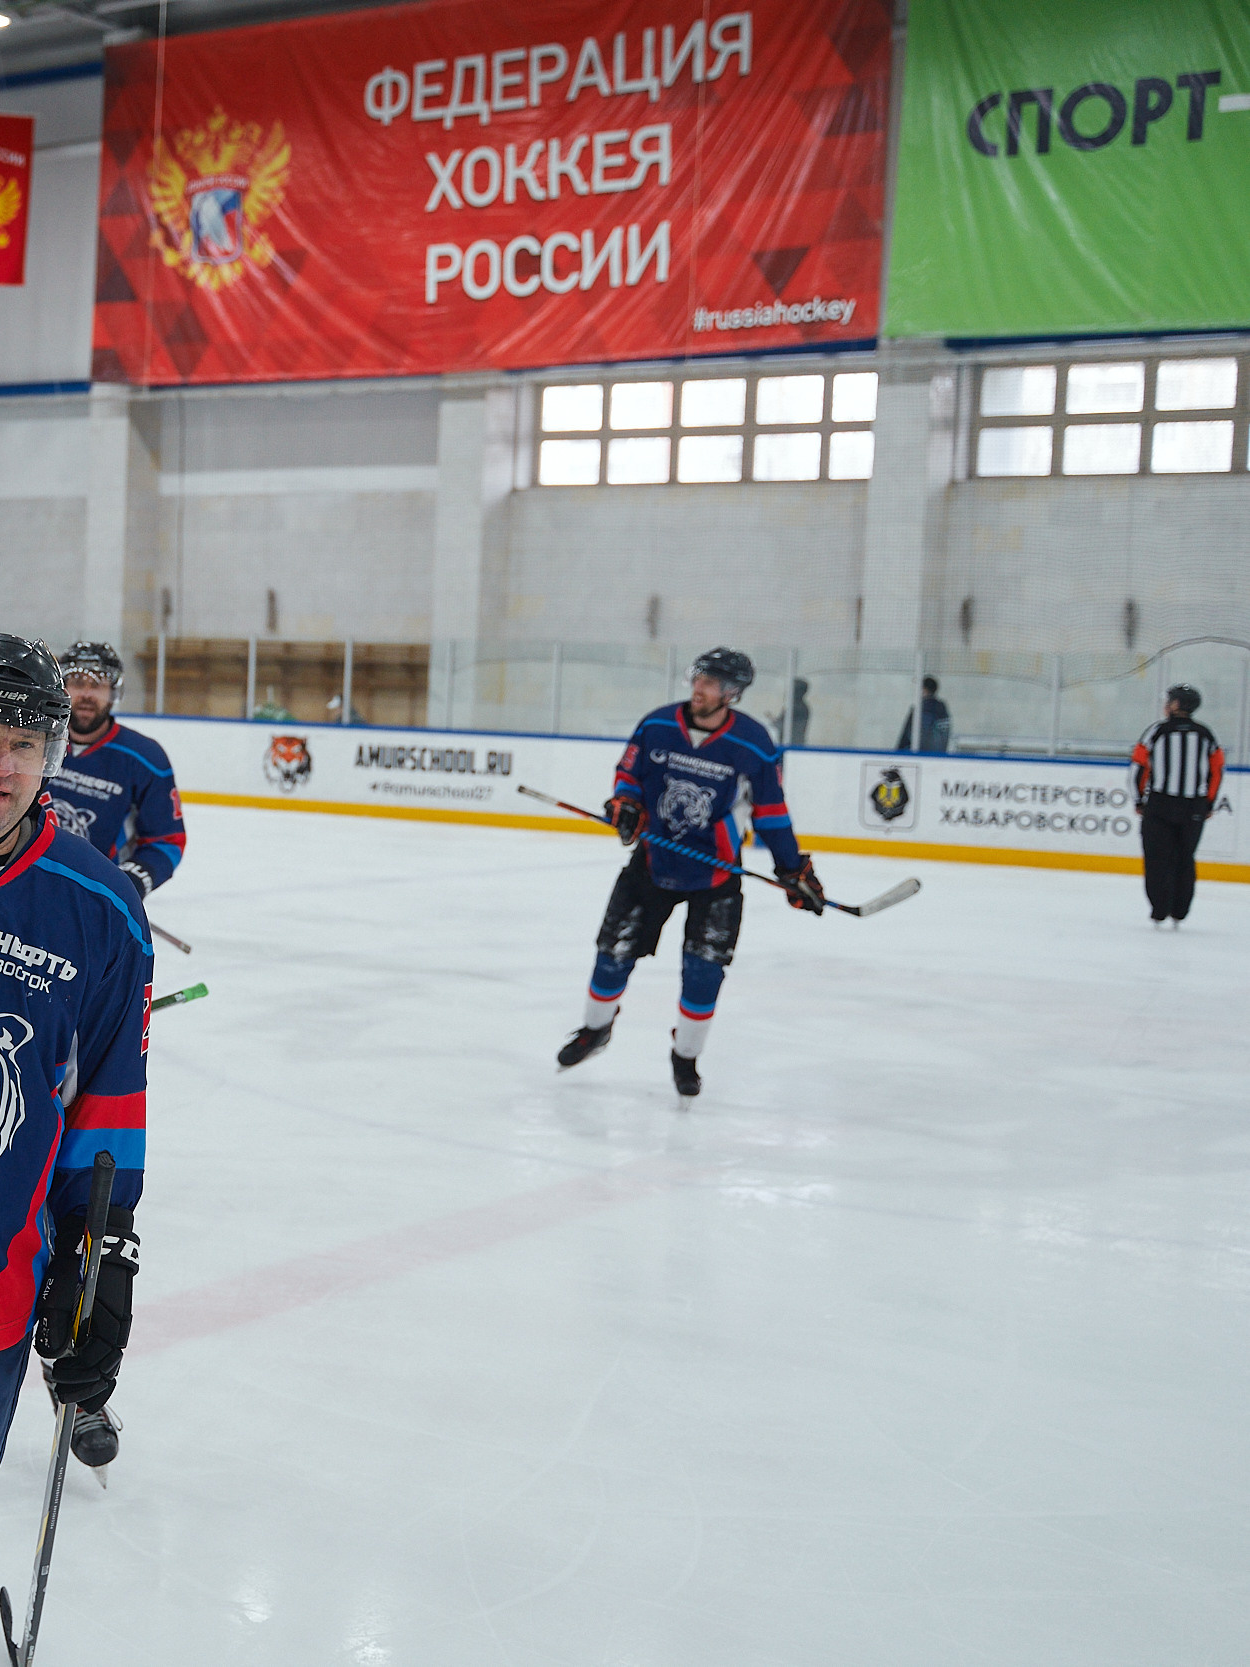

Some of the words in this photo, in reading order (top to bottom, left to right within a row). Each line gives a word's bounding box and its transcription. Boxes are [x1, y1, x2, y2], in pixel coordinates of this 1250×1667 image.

[364, 11, 752, 128] ФЕДЕРАЦИЯ
[966, 70, 1222, 158] СПОРТ
[424, 122, 673, 212] ХОККЕЯ
[424, 220, 672, 304] РОССИИ
[693, 295, 857, 332] #russiahockey
[354, 744, 513, 777] AMURSCHOOL.RU
[938, 807, 1132, 837] ХАБАРОВСКОГО
[940, 779, 1129, 809] МИНИСТЕРСТВО
